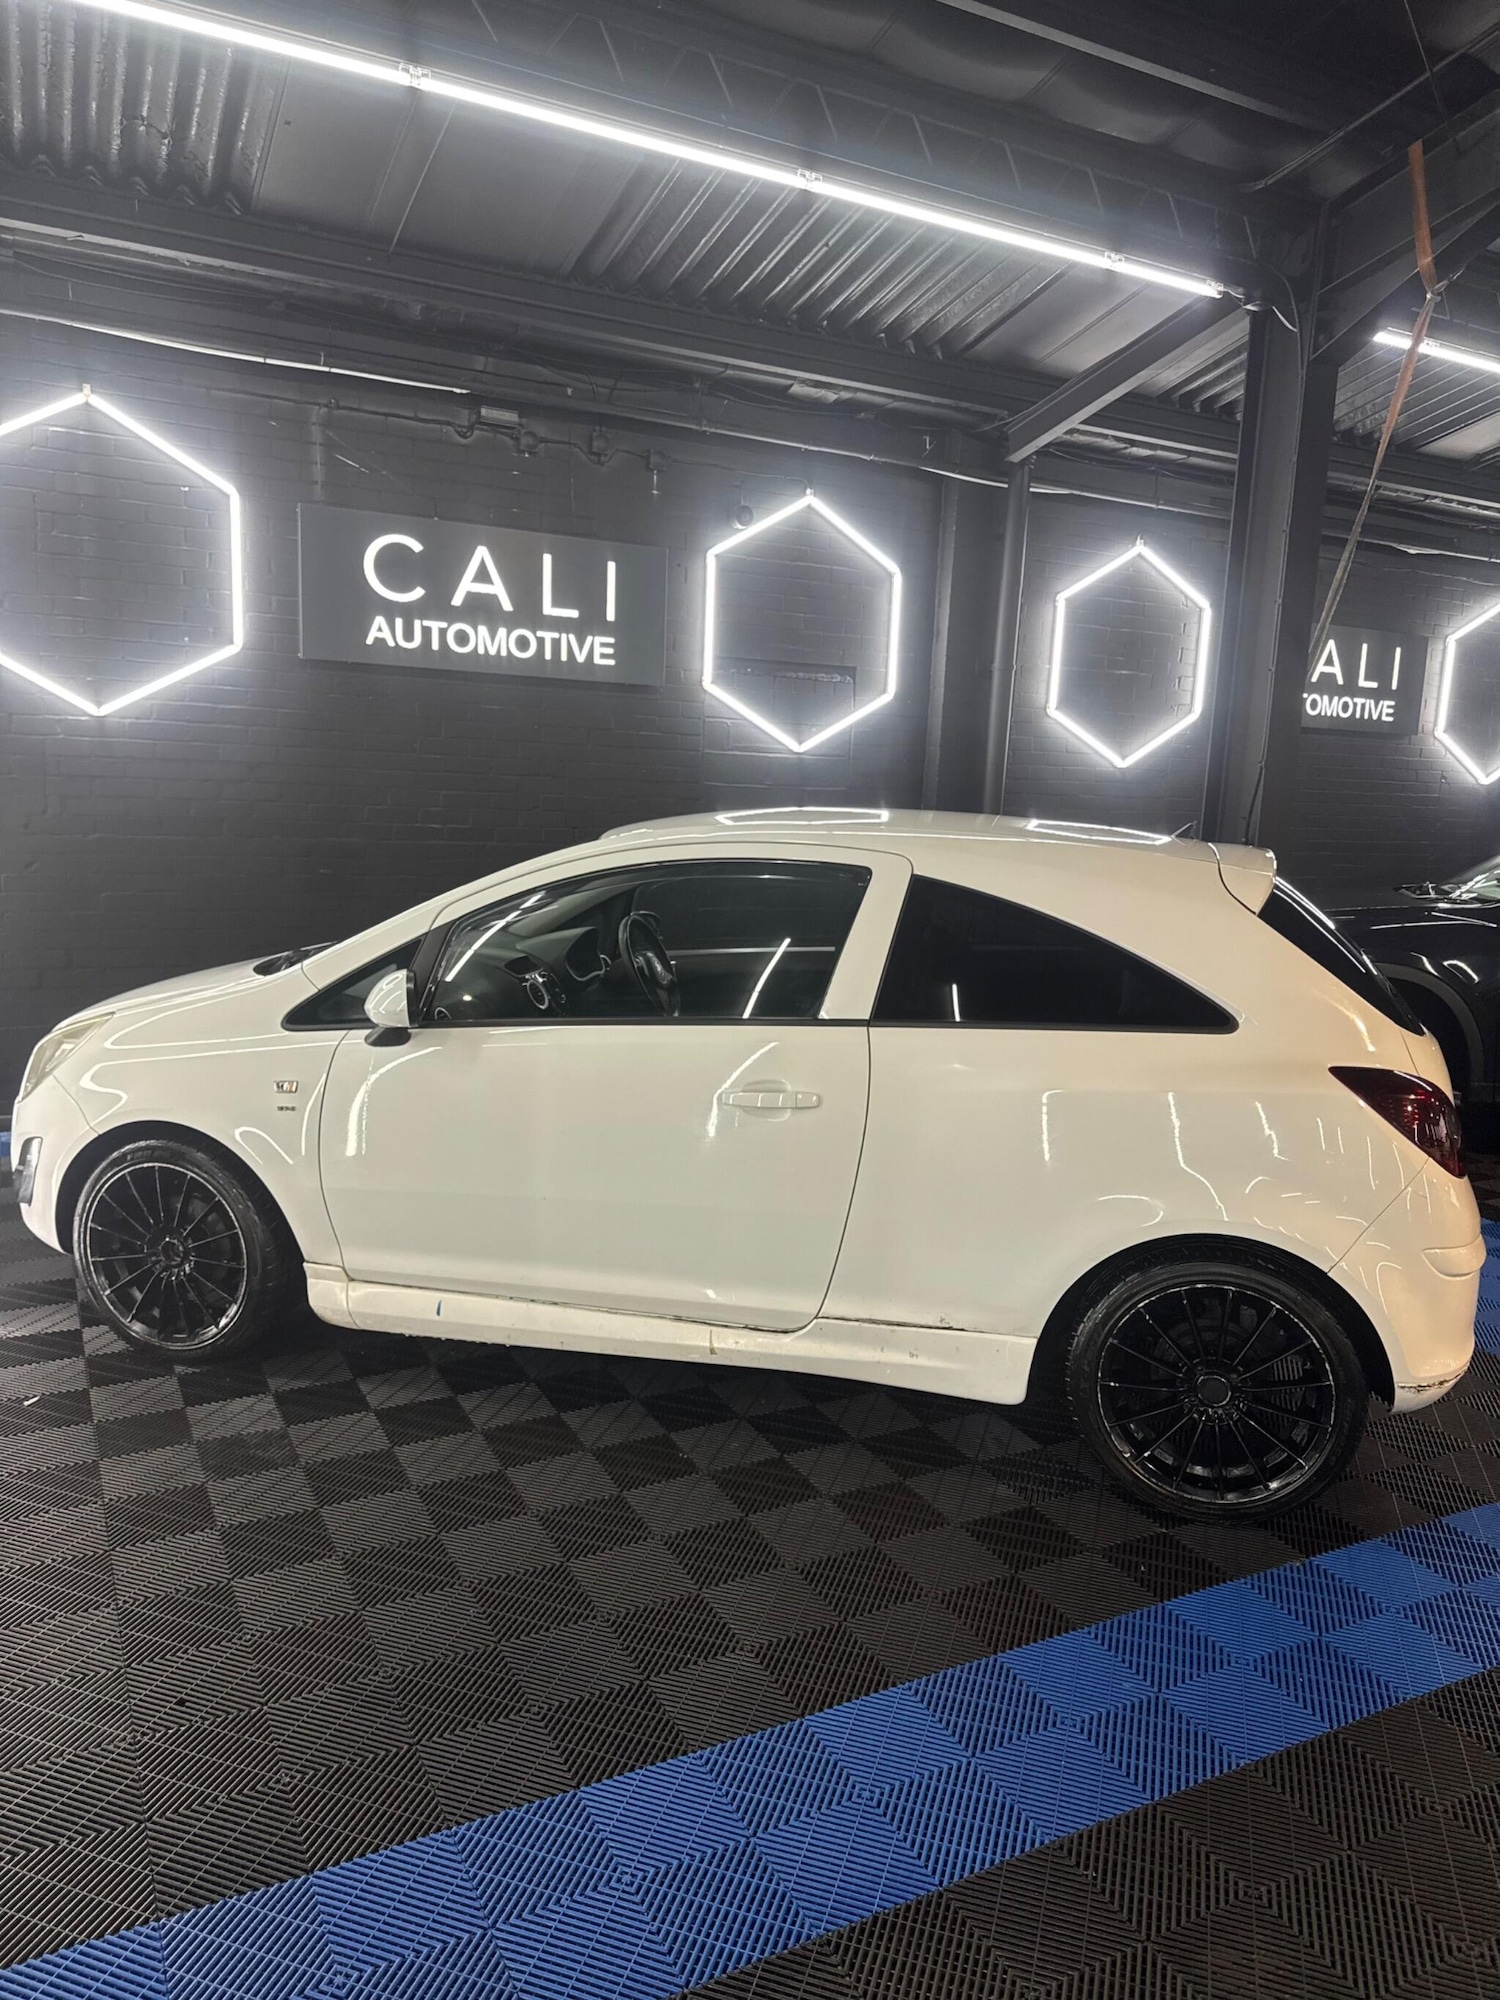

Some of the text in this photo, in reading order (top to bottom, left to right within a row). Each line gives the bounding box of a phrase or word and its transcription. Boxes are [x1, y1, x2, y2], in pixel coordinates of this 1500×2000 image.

[363, 533, 617, 622] CALI
[365, 615, 616, 666] AUTOMOTIVE
[1302, 692, 1396, 722] OMOTIVE
